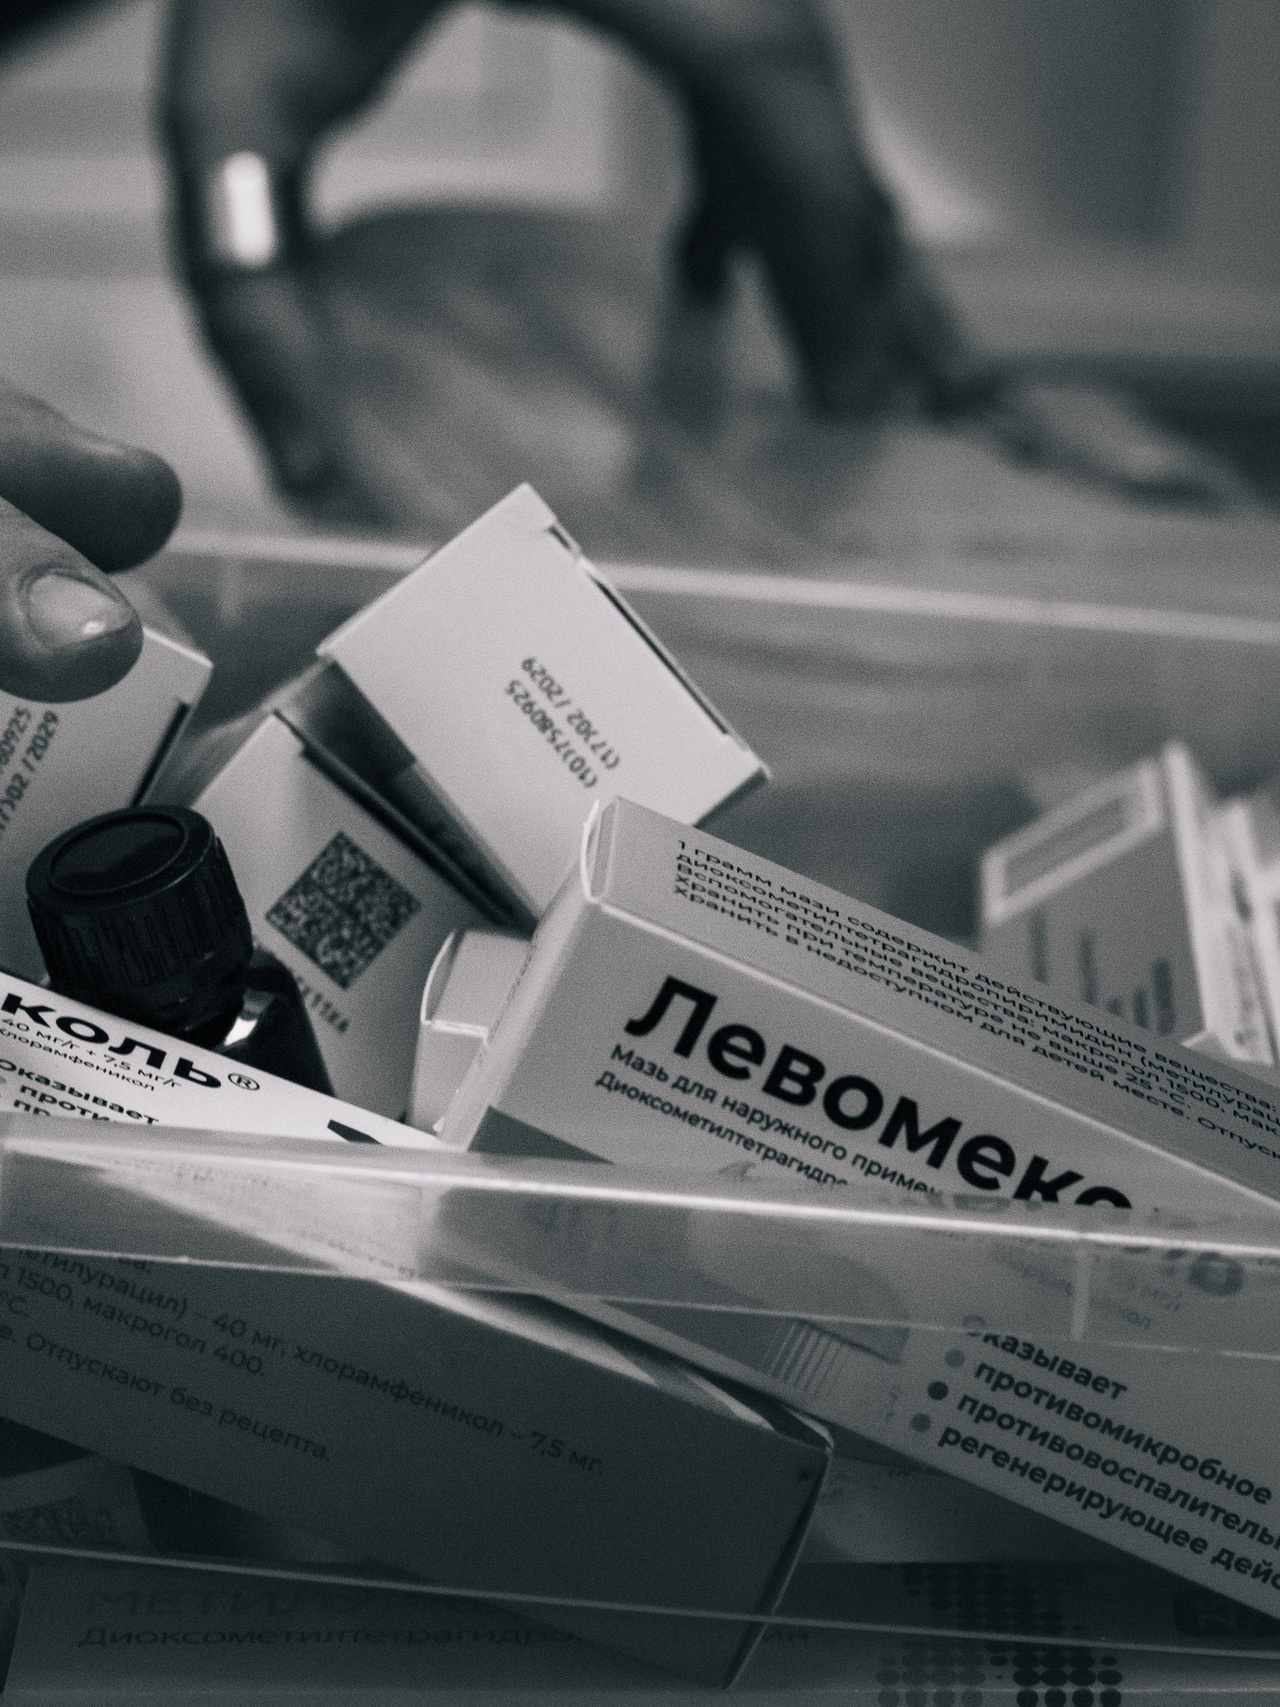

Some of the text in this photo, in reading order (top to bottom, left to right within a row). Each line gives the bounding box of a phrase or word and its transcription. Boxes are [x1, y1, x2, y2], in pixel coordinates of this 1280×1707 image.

[674, 885, 779, 937] Хранить
[785, 933, 800, 946] в
[805, 944, 974, 1024] недоступном
[979, 1021, 1026, 1047] для
[1031, 1044, 1106, 1082] детей
[1111, 1079, 1191, 1121] месте.
[676, 863, 903, 967] Вспомогательные
[1042, 1025, 1160, 1083] макрогол
[676, 874, 780, 926] Хранить
[786, 922, 835, 950] при
[840, 948, 1004, 1025] температуре
[1011, 1022, 1042, 1041] не
[1048, 1039, 1119, 1077] выше
[1124, 1072, 1153, 1091] 25
[694, 848, 773, 887] грамм
[779, 885, 840, 918] мази
[846, 915, 970, 973] содержит
[974, 972, 1148, 1054] действующие
[1, 1016, 31, 1033] 40
[35, 1029, 81, 1051] мг/г
[136, 1068, 183, 1090] мг/г
[609, 1042, 670, 1085] Мазь
[670, 1073, 720, 1106] для
[721, 1094, 850, 1162] наружного
[17, 1266, 74, 1309] 1500,
[82, 1296, 208, 1355] макрогол
[212, 1344, 265, 1377] 400.
[18, 1247, 189, 1320] етилурацил)
[212, 1312, 248, 1338] 40
[292, 1346, 505, 1438] хлорамфеникол
[26, 1331, 166, 1397] Отпускают
[170, 1386, 214, 1417] без
[217, 1409, 331, 1463] рецепта.
[956, 1393, 1280, 1550] противовоспалитель
[972, 1360, 1273, 1504] противомикробное
[938, 1426, 1208, 1555] регенерирующее
